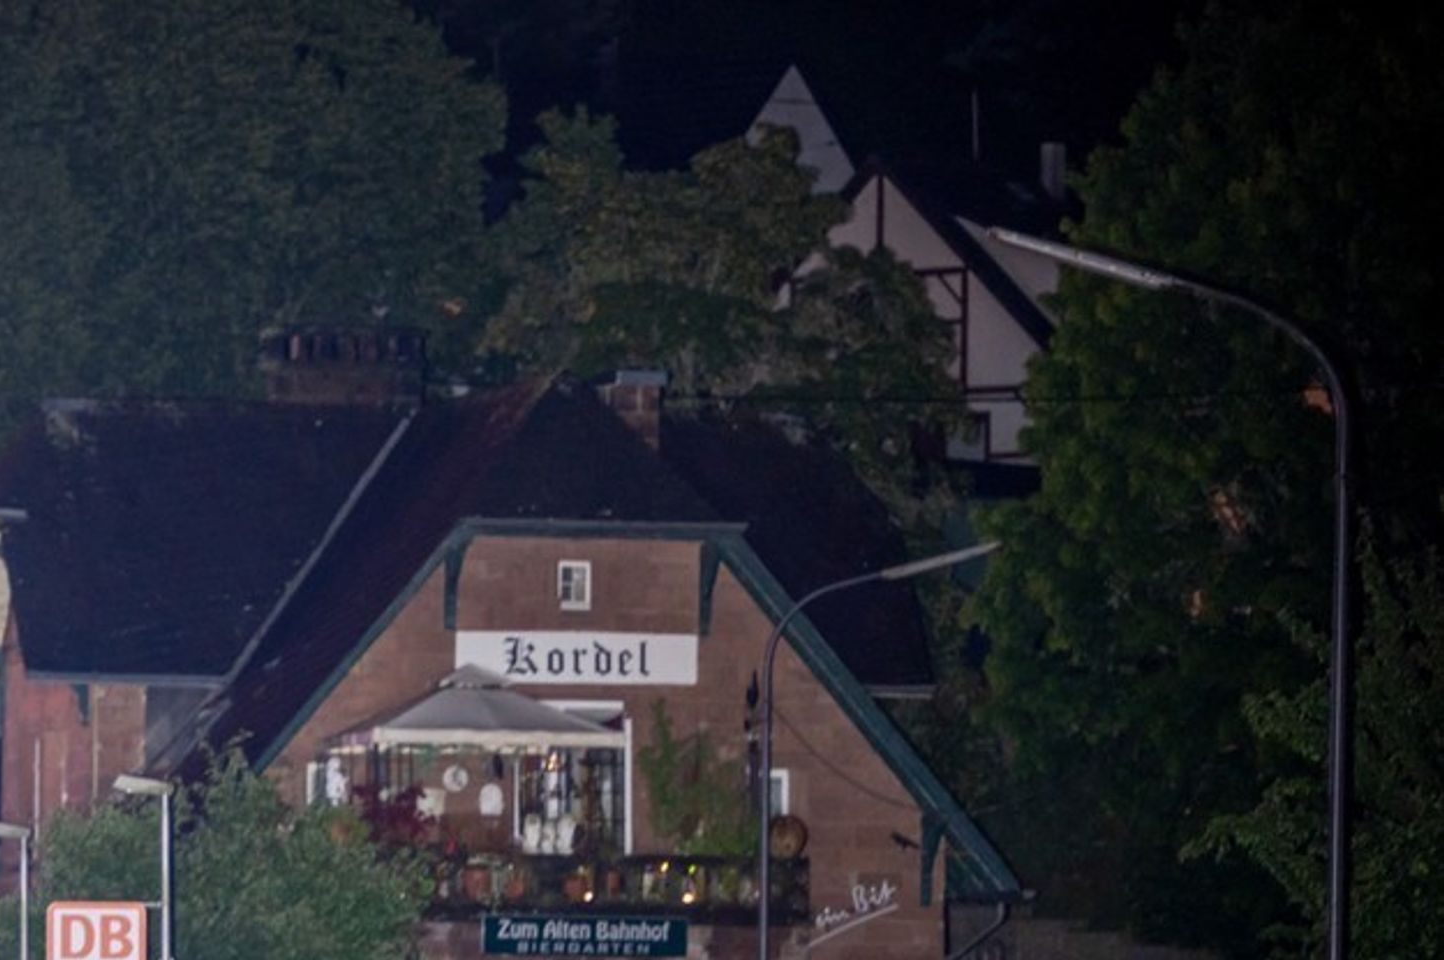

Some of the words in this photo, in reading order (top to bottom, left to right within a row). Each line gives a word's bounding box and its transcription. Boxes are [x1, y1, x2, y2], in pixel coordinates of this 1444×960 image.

[504, 636, 651, 677] Kordel
[852, 878, 897, 913] Bit
[60, 914, 133, 959] DB
[497, 919, 539, 940] Zum
[543, 919, 591, 940] Alten
[595, 920, 670, 942] Bahnhof
